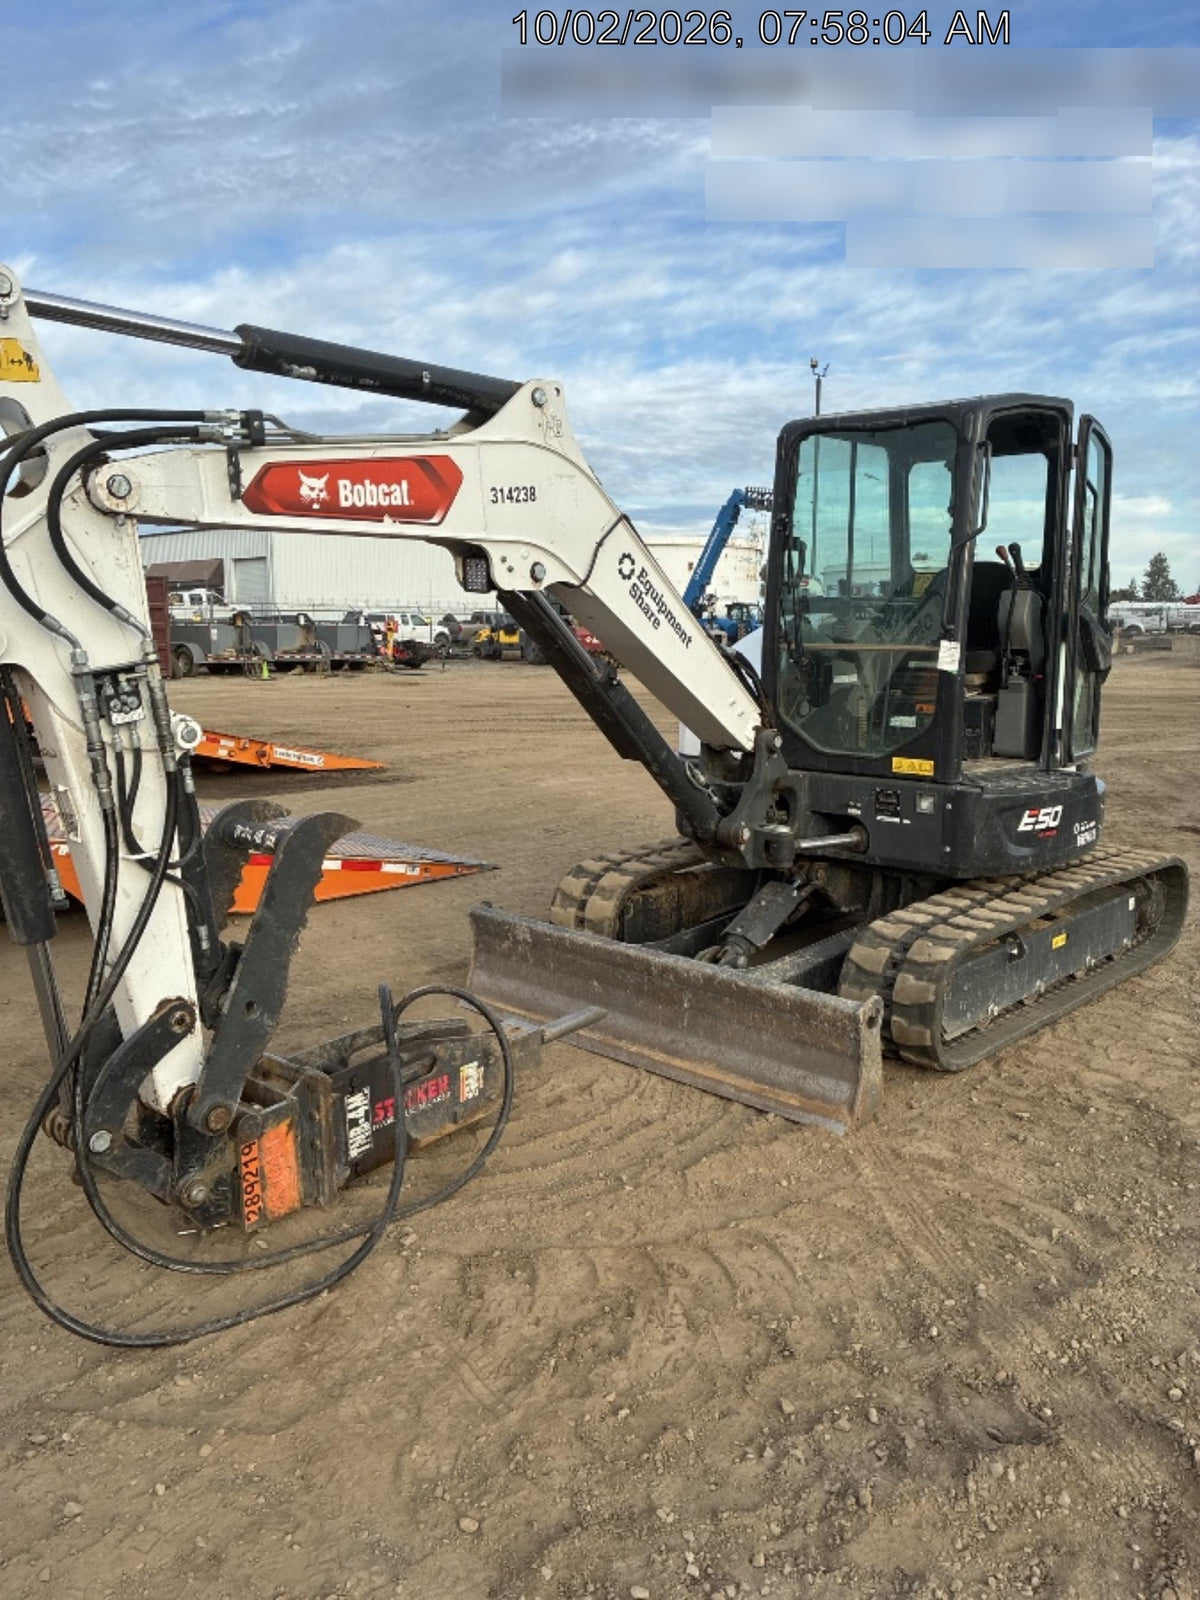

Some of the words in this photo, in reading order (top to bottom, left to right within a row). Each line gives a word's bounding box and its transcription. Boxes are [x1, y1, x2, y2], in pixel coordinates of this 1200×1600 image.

[337, 479, 409, 507] Bobcat
[490, 486, 537, 504] 314238
[629, 583, 660, 630] Share
[636, 567, 692, 649] Equipment
[1017, 805, 1064, 832] E50
